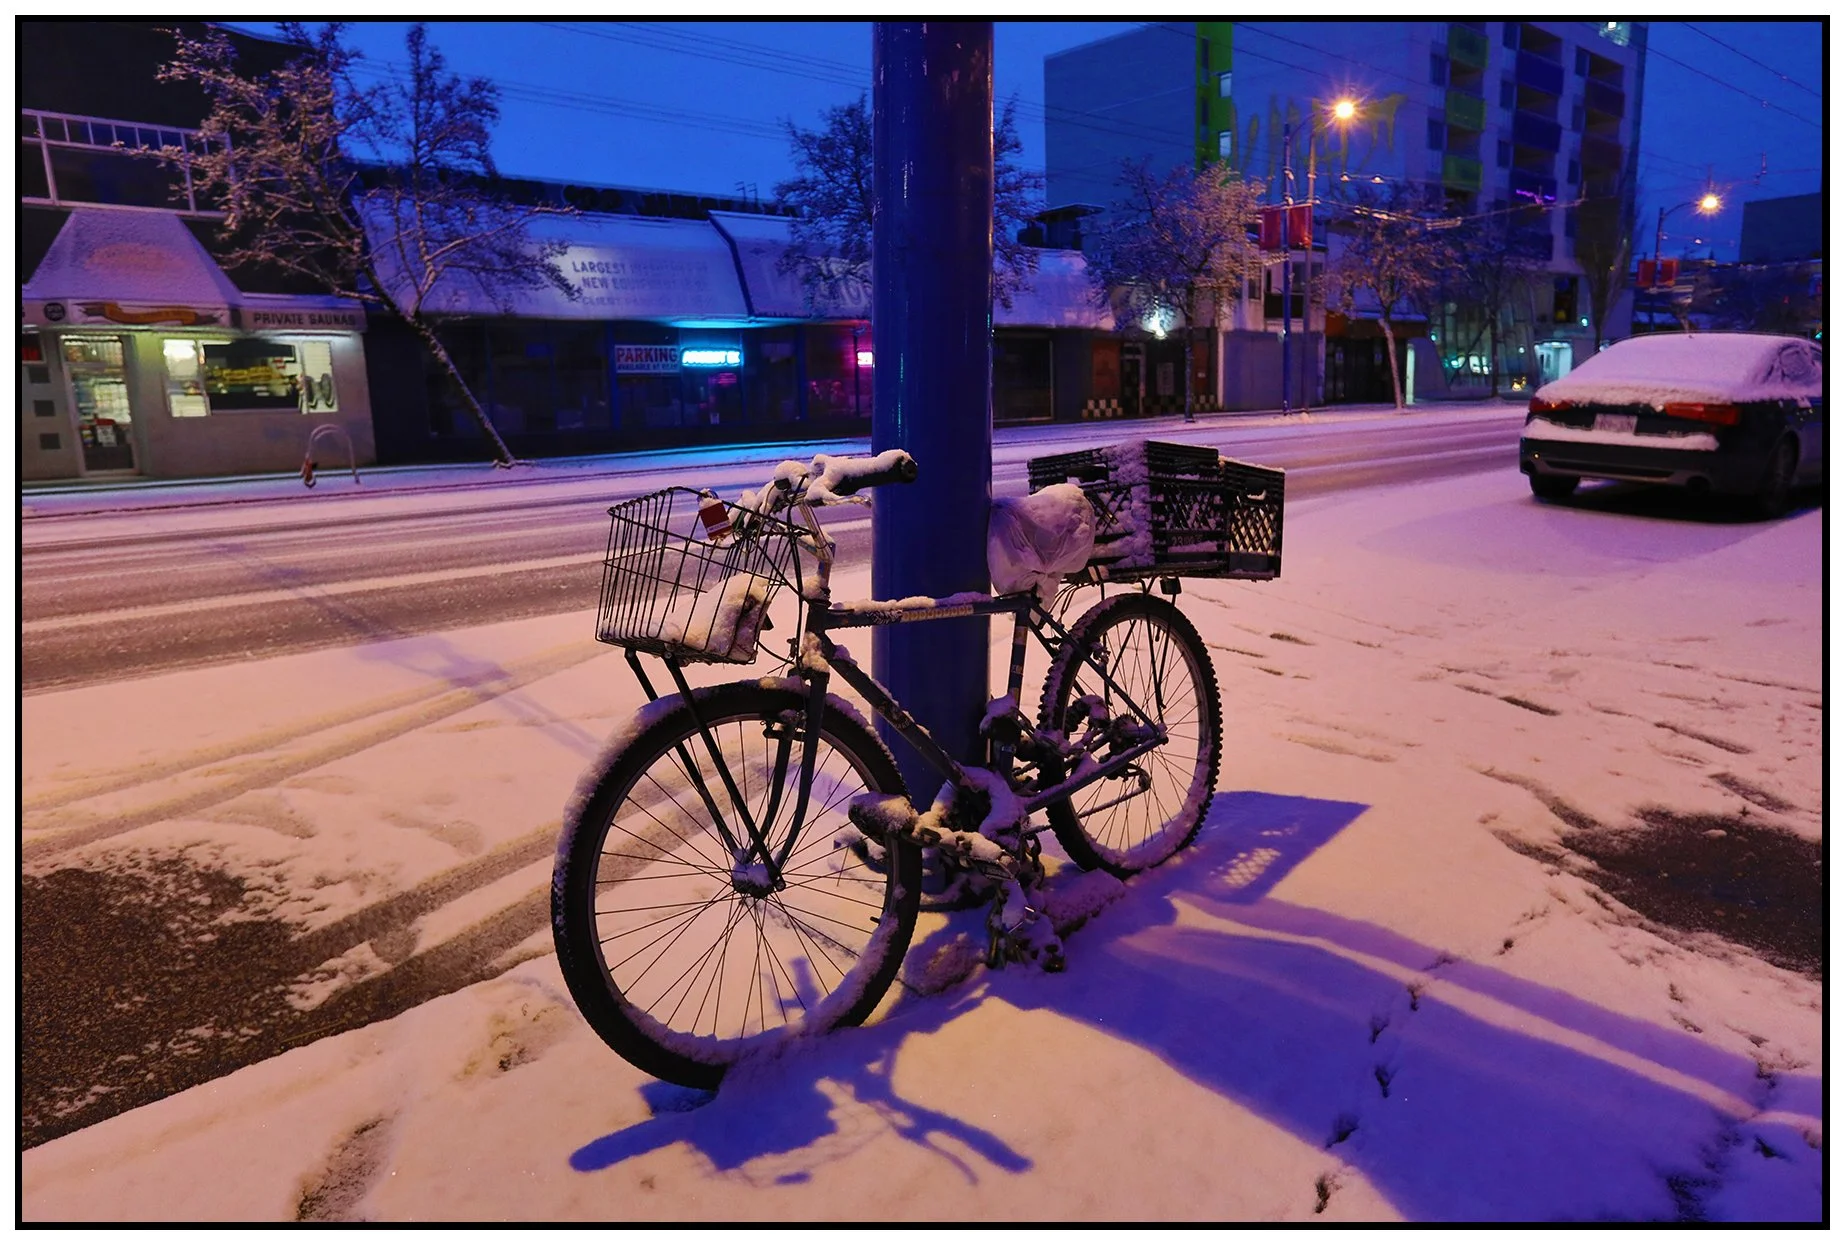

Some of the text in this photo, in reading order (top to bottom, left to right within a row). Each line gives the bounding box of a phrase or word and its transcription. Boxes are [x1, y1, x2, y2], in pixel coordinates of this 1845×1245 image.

[572, 260, 627, 274] LARGEST
[581, 276, 609, 290] NEW
[253, 312, 304, 325] PRIVATE
[616, 347, 678, 362] PARKING
